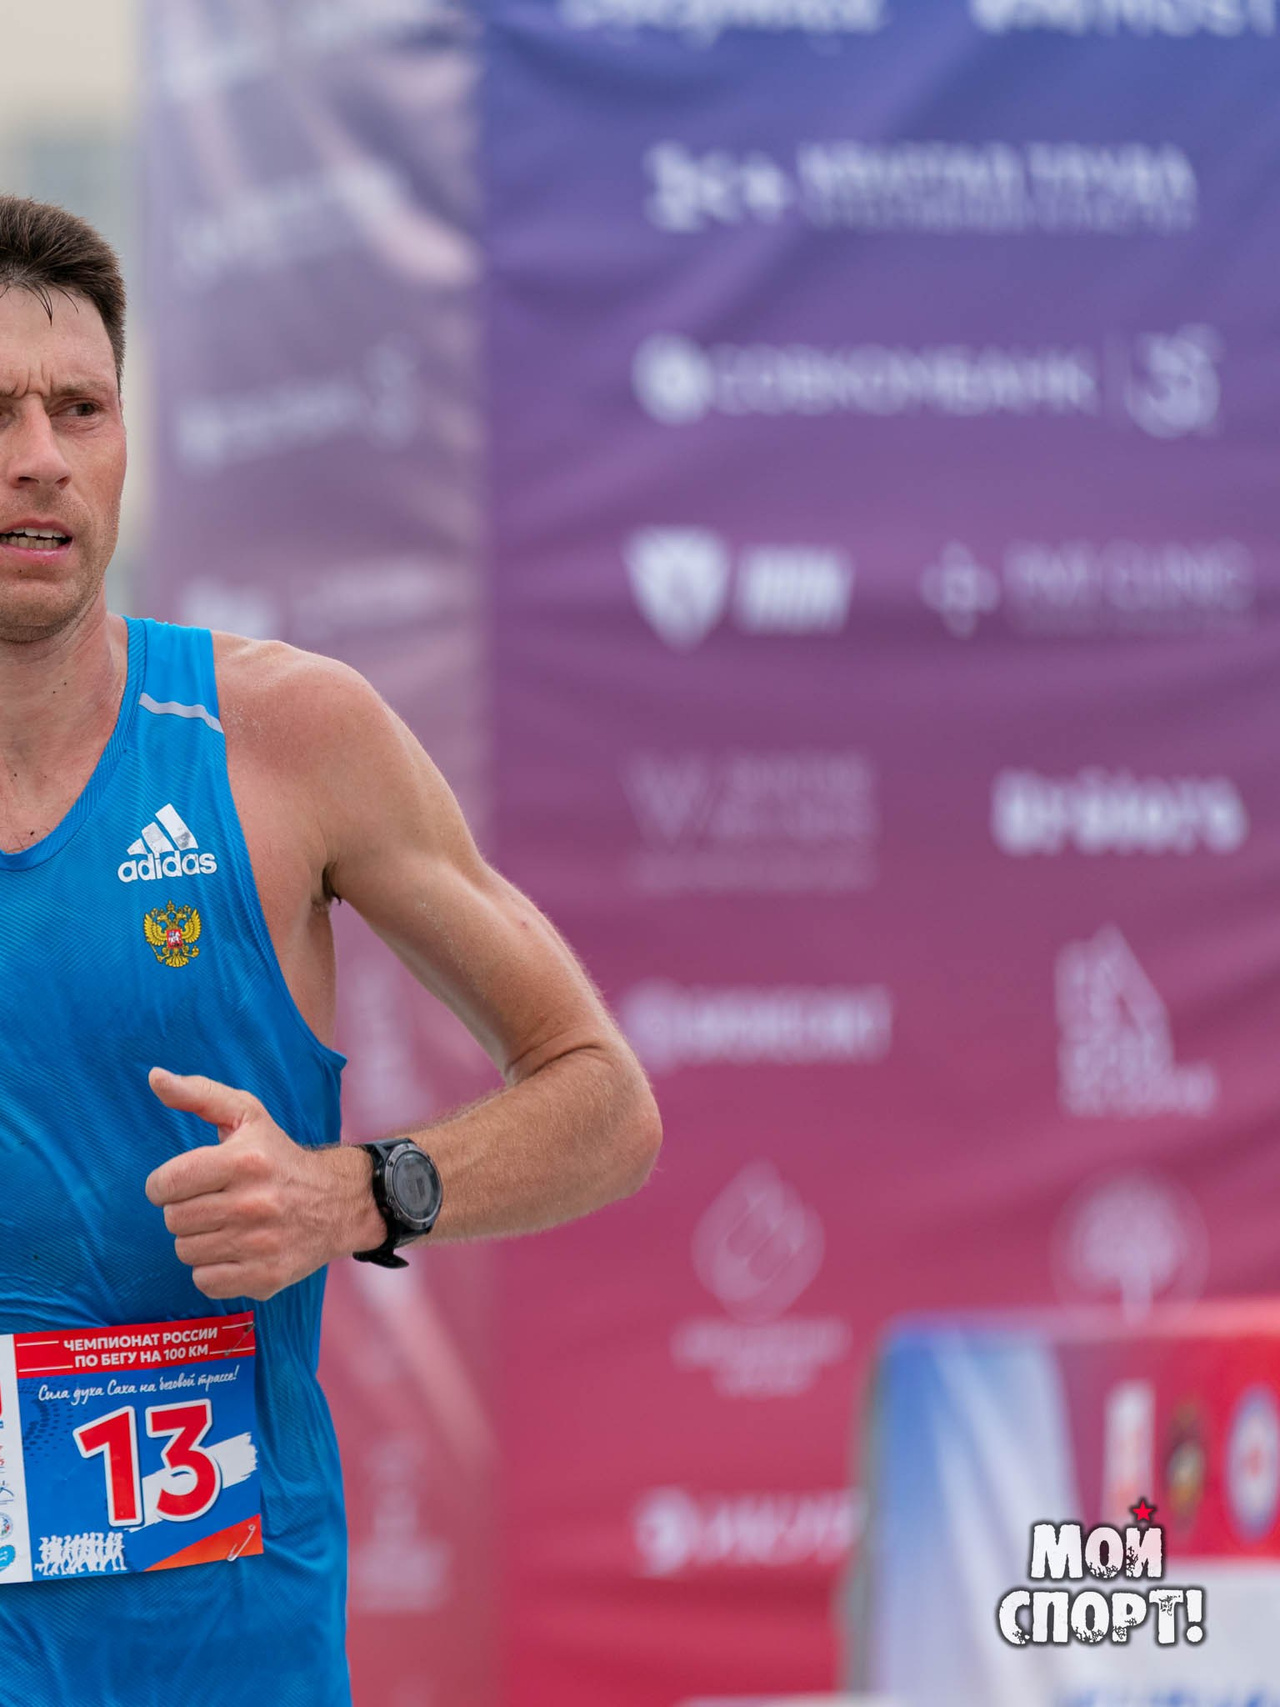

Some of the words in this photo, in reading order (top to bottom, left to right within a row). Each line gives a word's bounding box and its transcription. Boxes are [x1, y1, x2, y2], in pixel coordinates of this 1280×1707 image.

[118, 850, 218, 883] adidas
[63, 1333, 160, 1352] ЧЕМПИОНАТ
[162, 1327, 218, 1345] РОССИИ
[75, 1354, 99, 1368] ПО
[101, 1351, 137, 1366] БЕГУ
[140, 1350, 162, 1363] НА
[163, 1347, 186, 1361] 100
[188, 1344, 209, 1358] КМ
[38, 1384, 70, 1401] Сила
[70, 1386, 105, 1406] духа
[107, 1379, 137, 1396] Саха
[139, 1383, 157, 1393] на
[73, 1398, 222, 1528] 13
